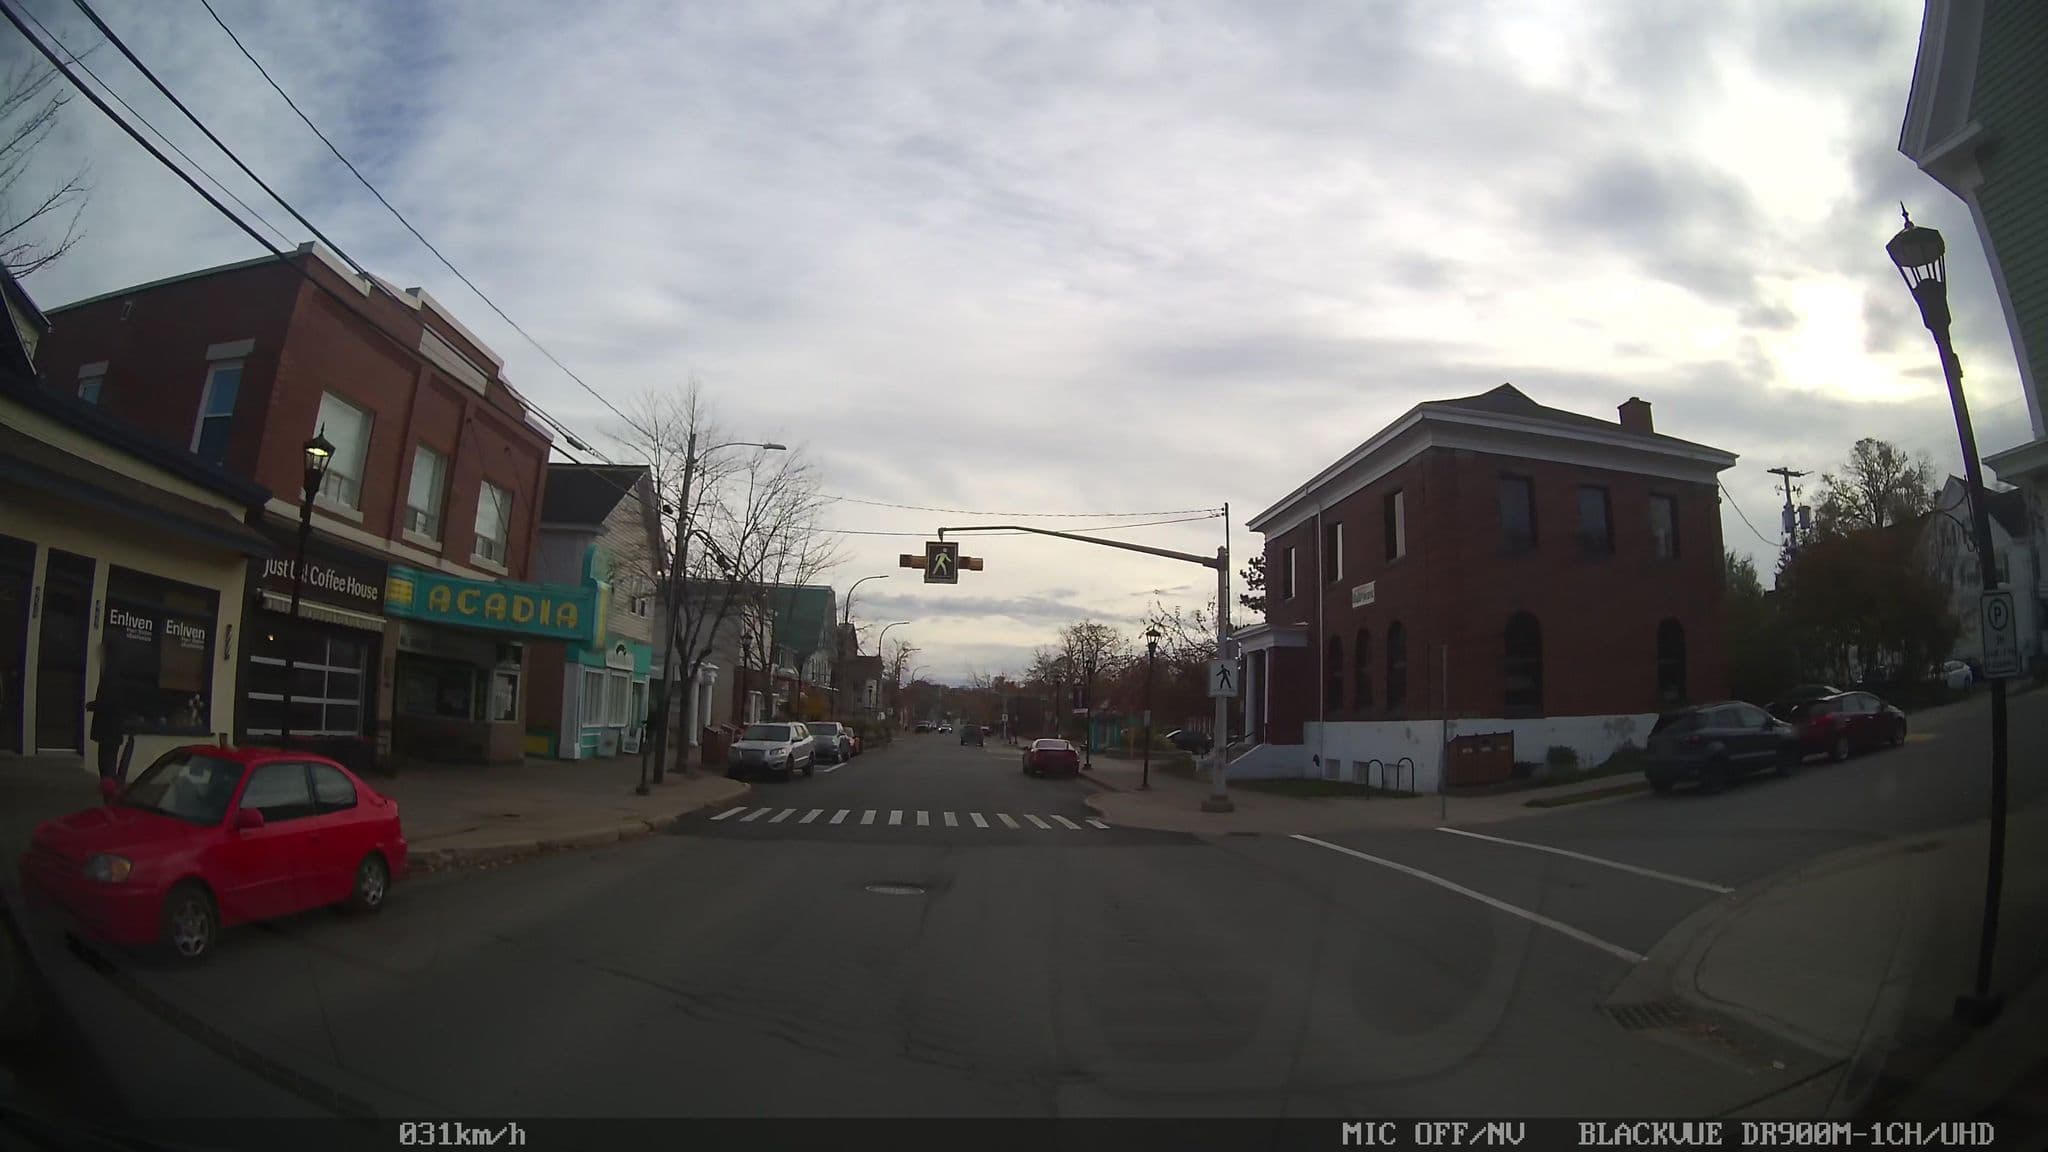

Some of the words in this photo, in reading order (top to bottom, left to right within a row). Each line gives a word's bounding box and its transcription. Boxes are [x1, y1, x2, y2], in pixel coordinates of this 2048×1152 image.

[290, 559, 309, 584] U!
[310, 565, 346, 592] Coffee
[347, 576, 378, 600] House
[109, 608, 153, 632] Enliven
[428, 583, 579, 630] ACADIA
[165, 619, 206, 640] Enliven
